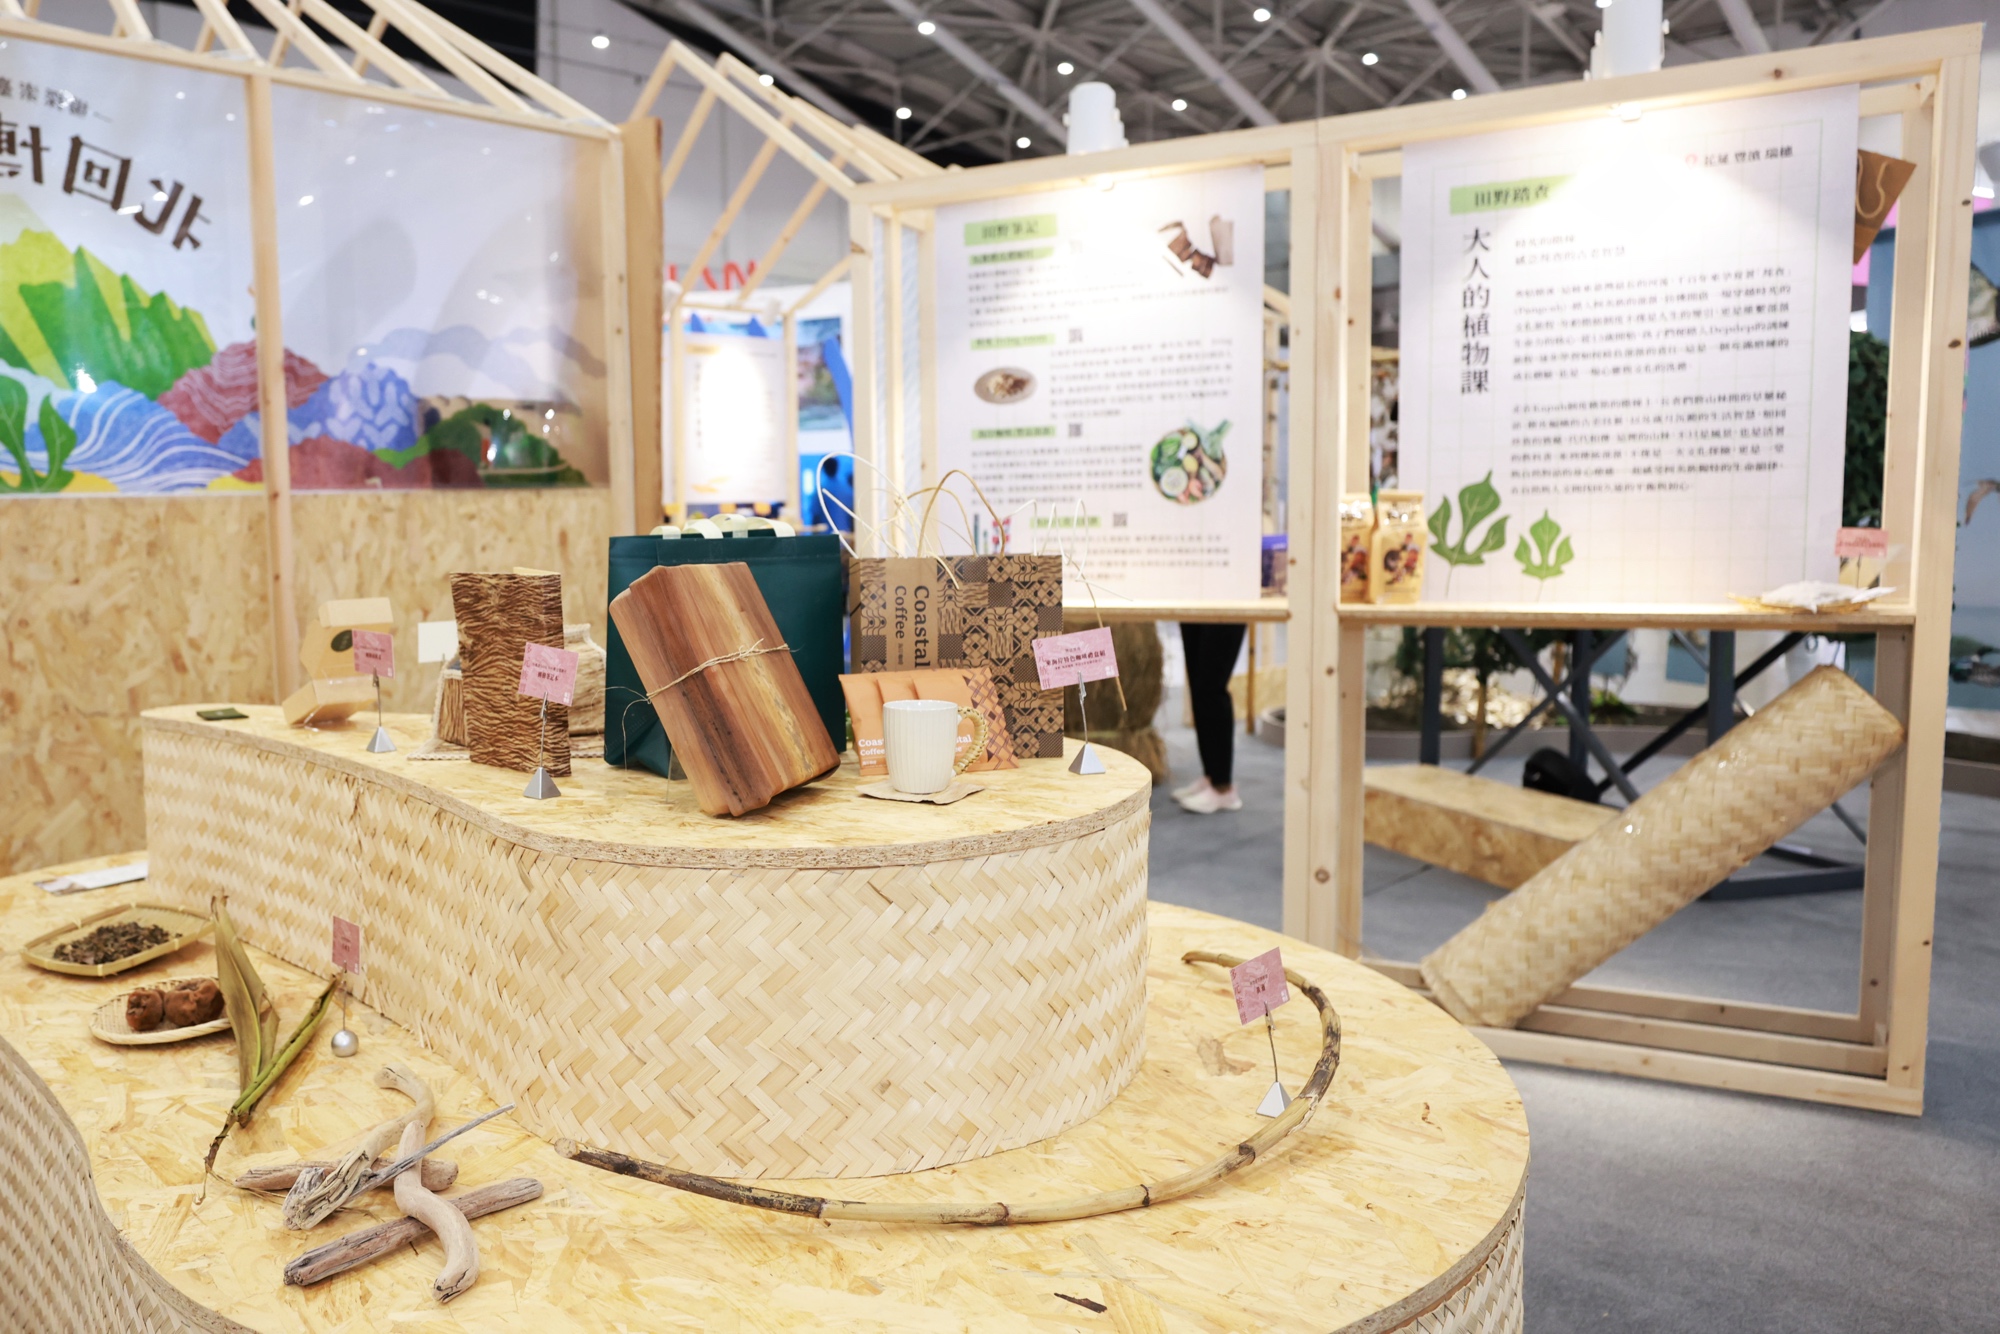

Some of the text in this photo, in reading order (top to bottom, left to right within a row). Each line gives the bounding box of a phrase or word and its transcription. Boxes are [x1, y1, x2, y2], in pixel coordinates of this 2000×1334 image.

[1474, 184, 1550, 208] 田野踏查
[1461, 227, 1491, 395] 大人的植物課
[894, 585, 908, 639] Coffee
[914, 585, 931, 668] Coastal
